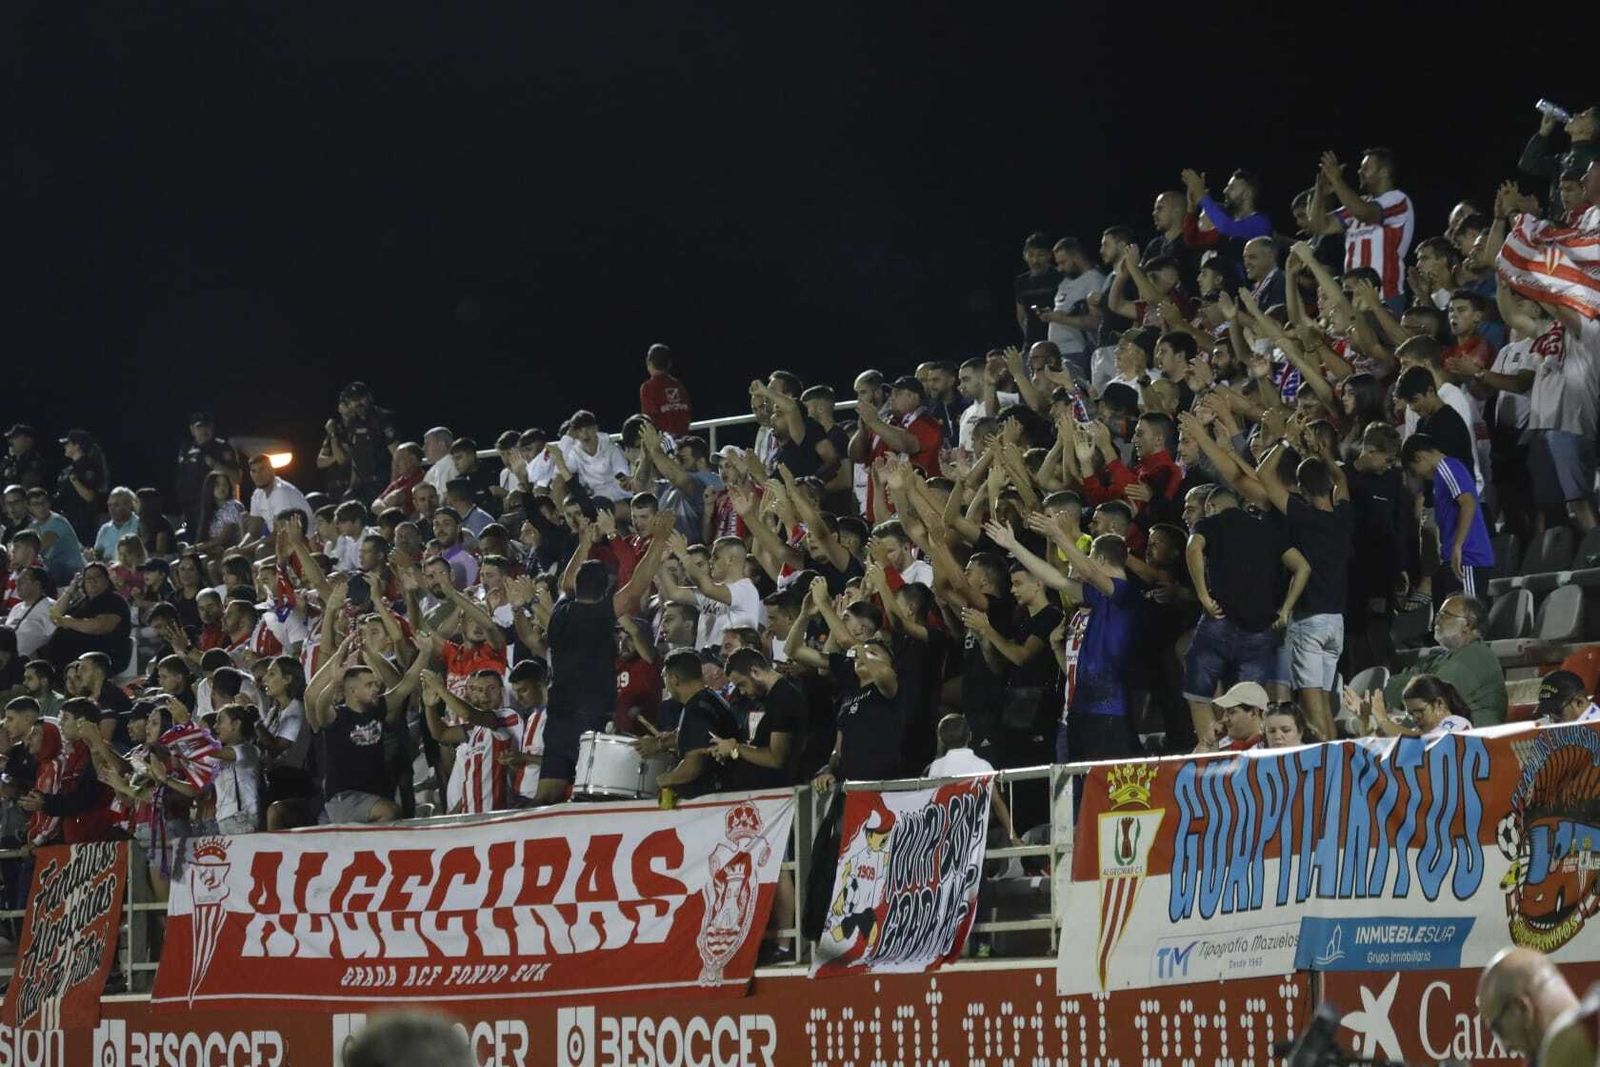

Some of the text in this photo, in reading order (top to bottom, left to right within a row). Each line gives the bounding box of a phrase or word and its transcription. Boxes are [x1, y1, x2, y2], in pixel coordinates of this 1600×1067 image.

[1168, 733, 1491, 924] GUAPITANITOS
[857, 864, 876, 880] 1909
[240, 828, 689, 958] ALGECIRAS
[1251, 933, 1299, 952] Mazuelos
[1355, 926, 1456, 944] INMUEBLESUR
[1367, 952, 1389, 963] Grupo
[340, 963, 552, 987] GRADA ACF FONDO SUR
[131, 1030, 284, 1067] BESOCCER
[601, 1015, 777, 1067] BESOCCER
